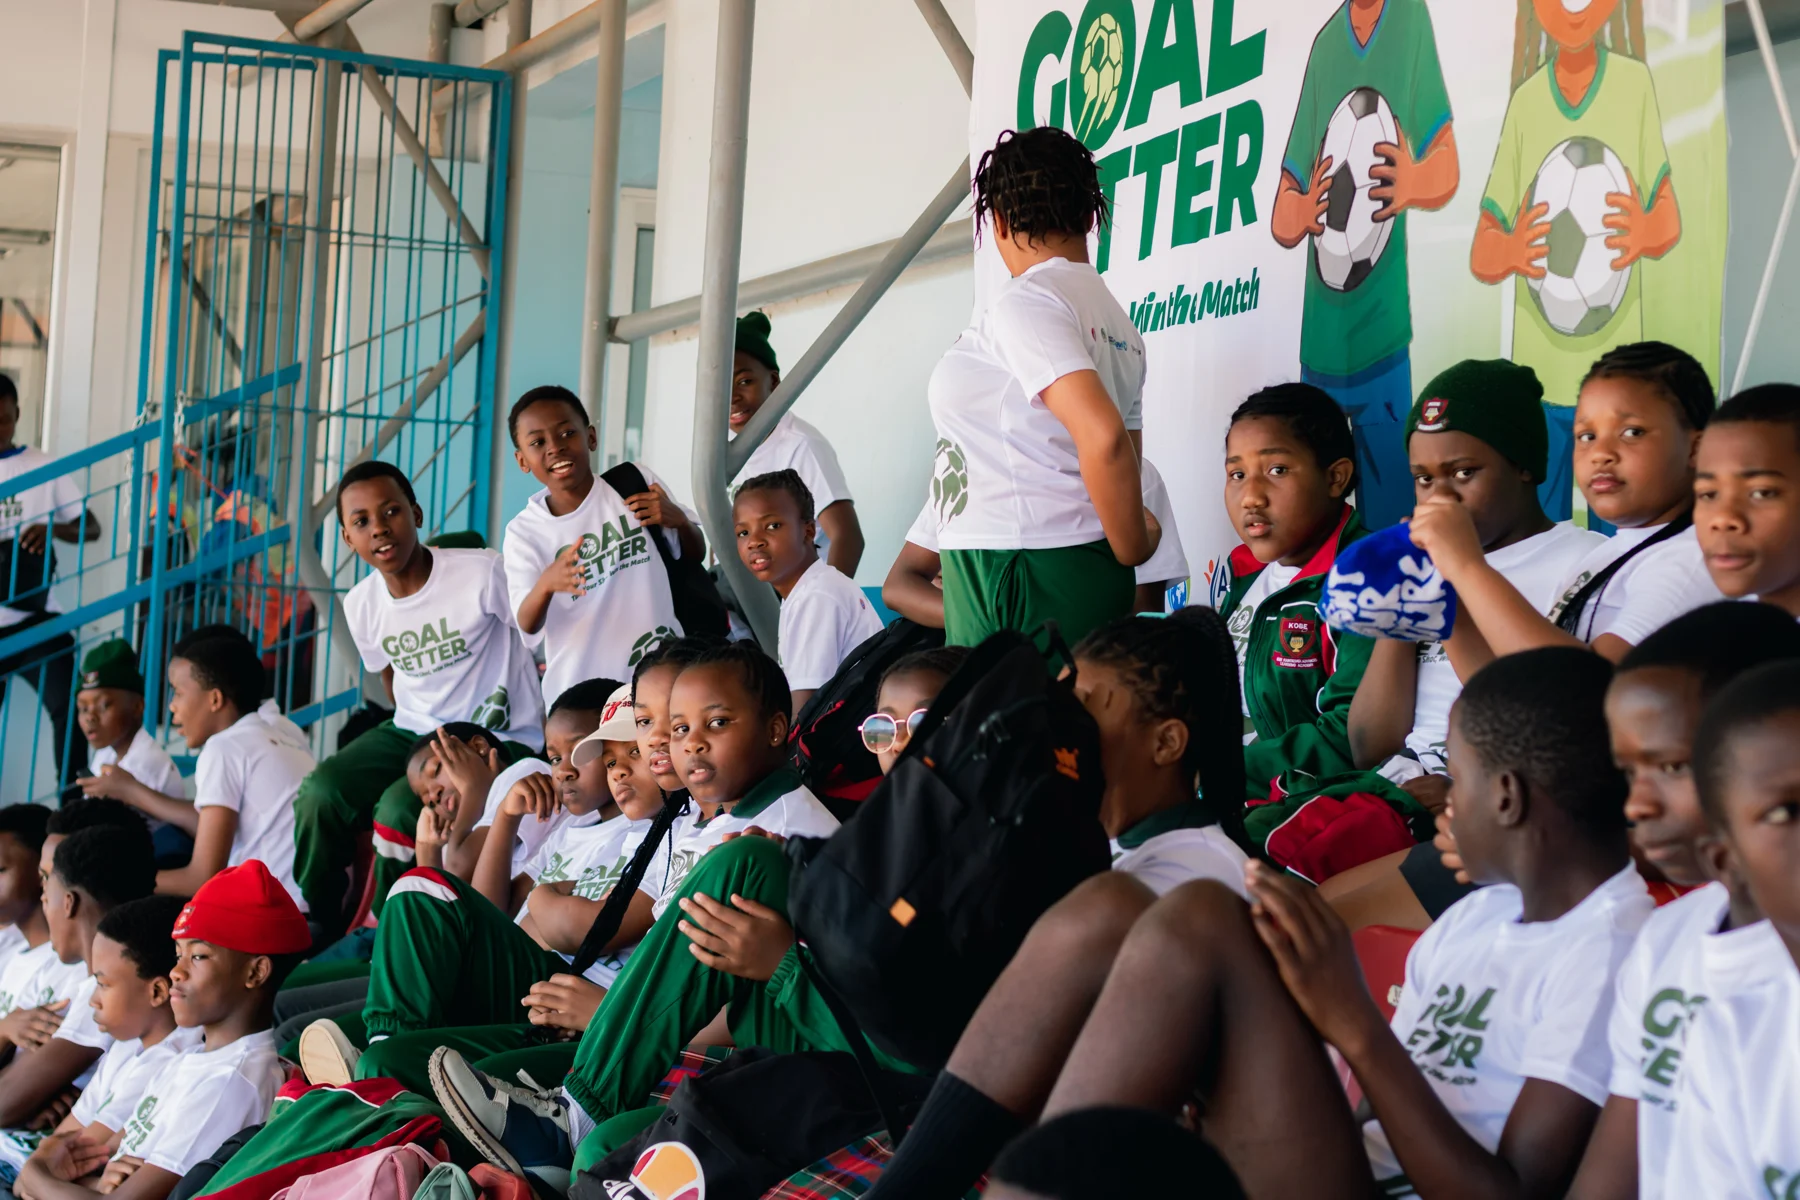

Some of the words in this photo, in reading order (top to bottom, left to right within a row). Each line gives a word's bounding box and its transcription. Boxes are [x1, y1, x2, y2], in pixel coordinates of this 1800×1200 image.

[1016, 0, 1267, 152] GOAL
[1095, 99, 1265, 275] TTER
[1197, 266, 1260, 321] Match
[576, 535, 648, 585] ETTER
[382, 617, 461, 657] GOAL
